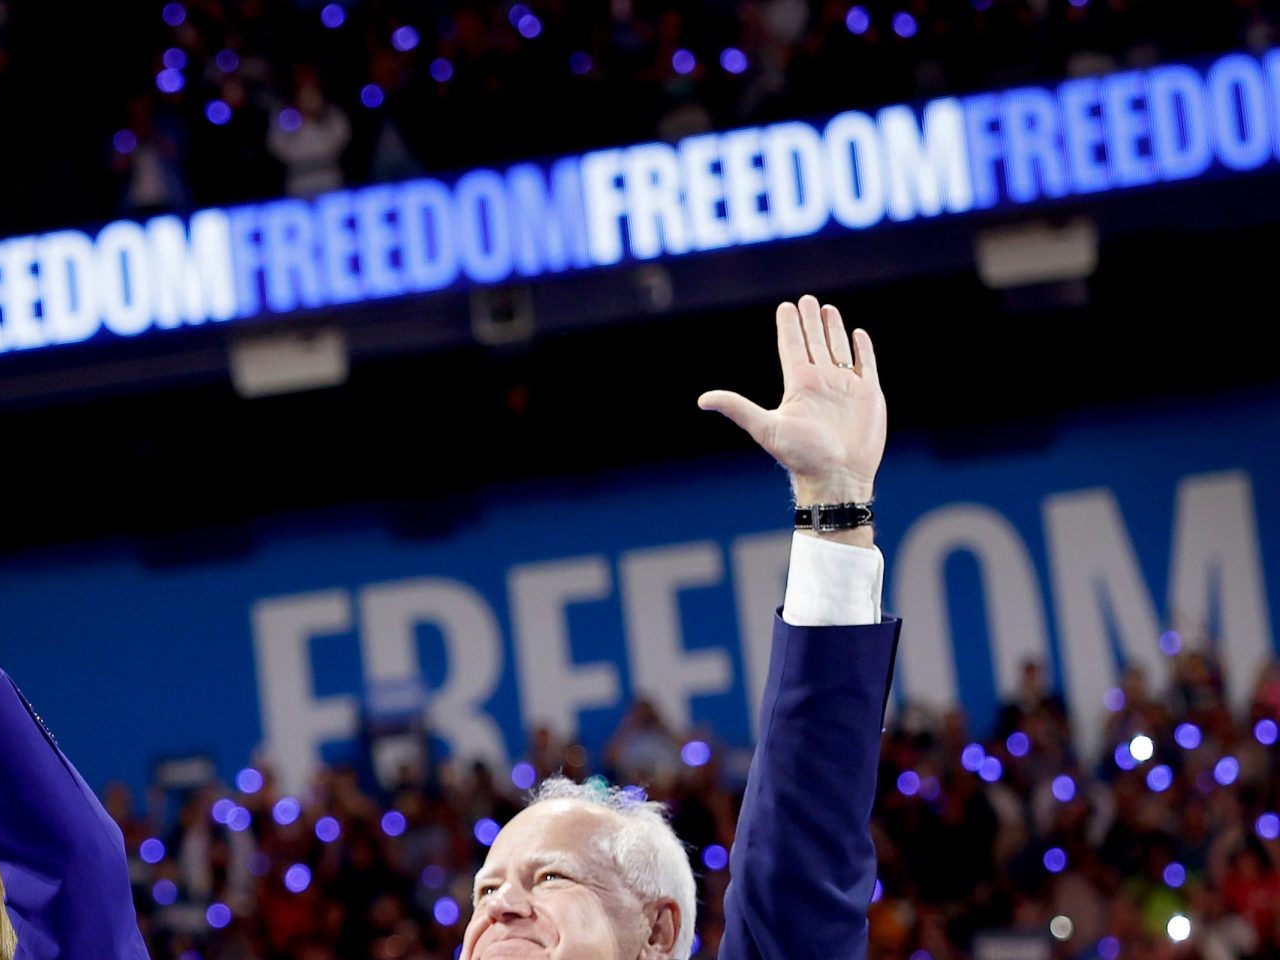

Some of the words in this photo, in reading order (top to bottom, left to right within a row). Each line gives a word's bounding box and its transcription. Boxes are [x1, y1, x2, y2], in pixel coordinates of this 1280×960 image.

[233, 158, 584, 317] FREEDOM
[580, 97, 972, 268] FREEDOM
[968, 48, 1280, 208] FREEDO
